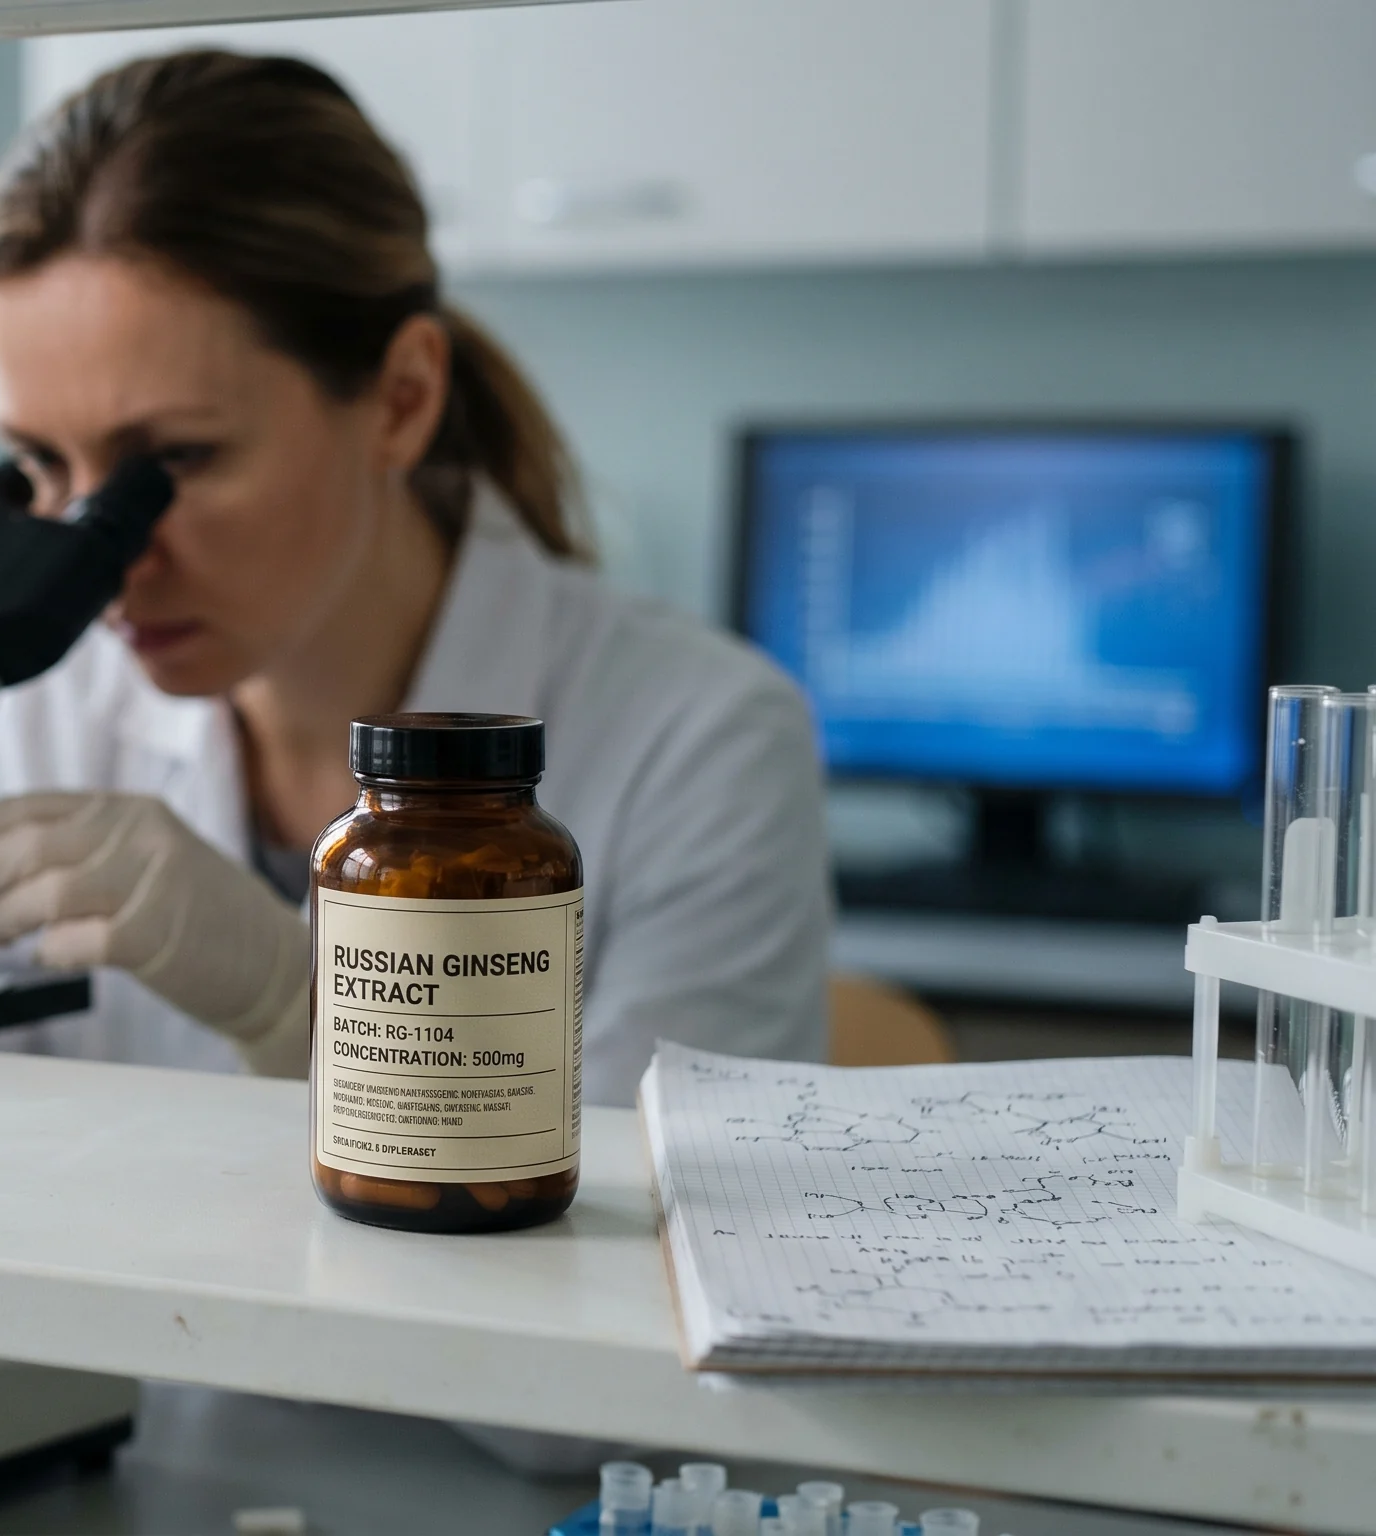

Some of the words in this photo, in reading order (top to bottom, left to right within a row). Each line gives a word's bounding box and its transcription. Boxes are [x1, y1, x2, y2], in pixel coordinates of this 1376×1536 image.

[334, 944, 434, 976] RUSSIAN
[442, 950, 550, 977] GINSENG
[334, 974, 440, 1006] EXTRACT
[333, 1016, 382, 1038] BATCH:
[386, 1024, 454, 1043] RG-1104
[333, 1040, 468, 1067] CONCENTRATION:
[472, 1050, 525, 1068] 500mg
